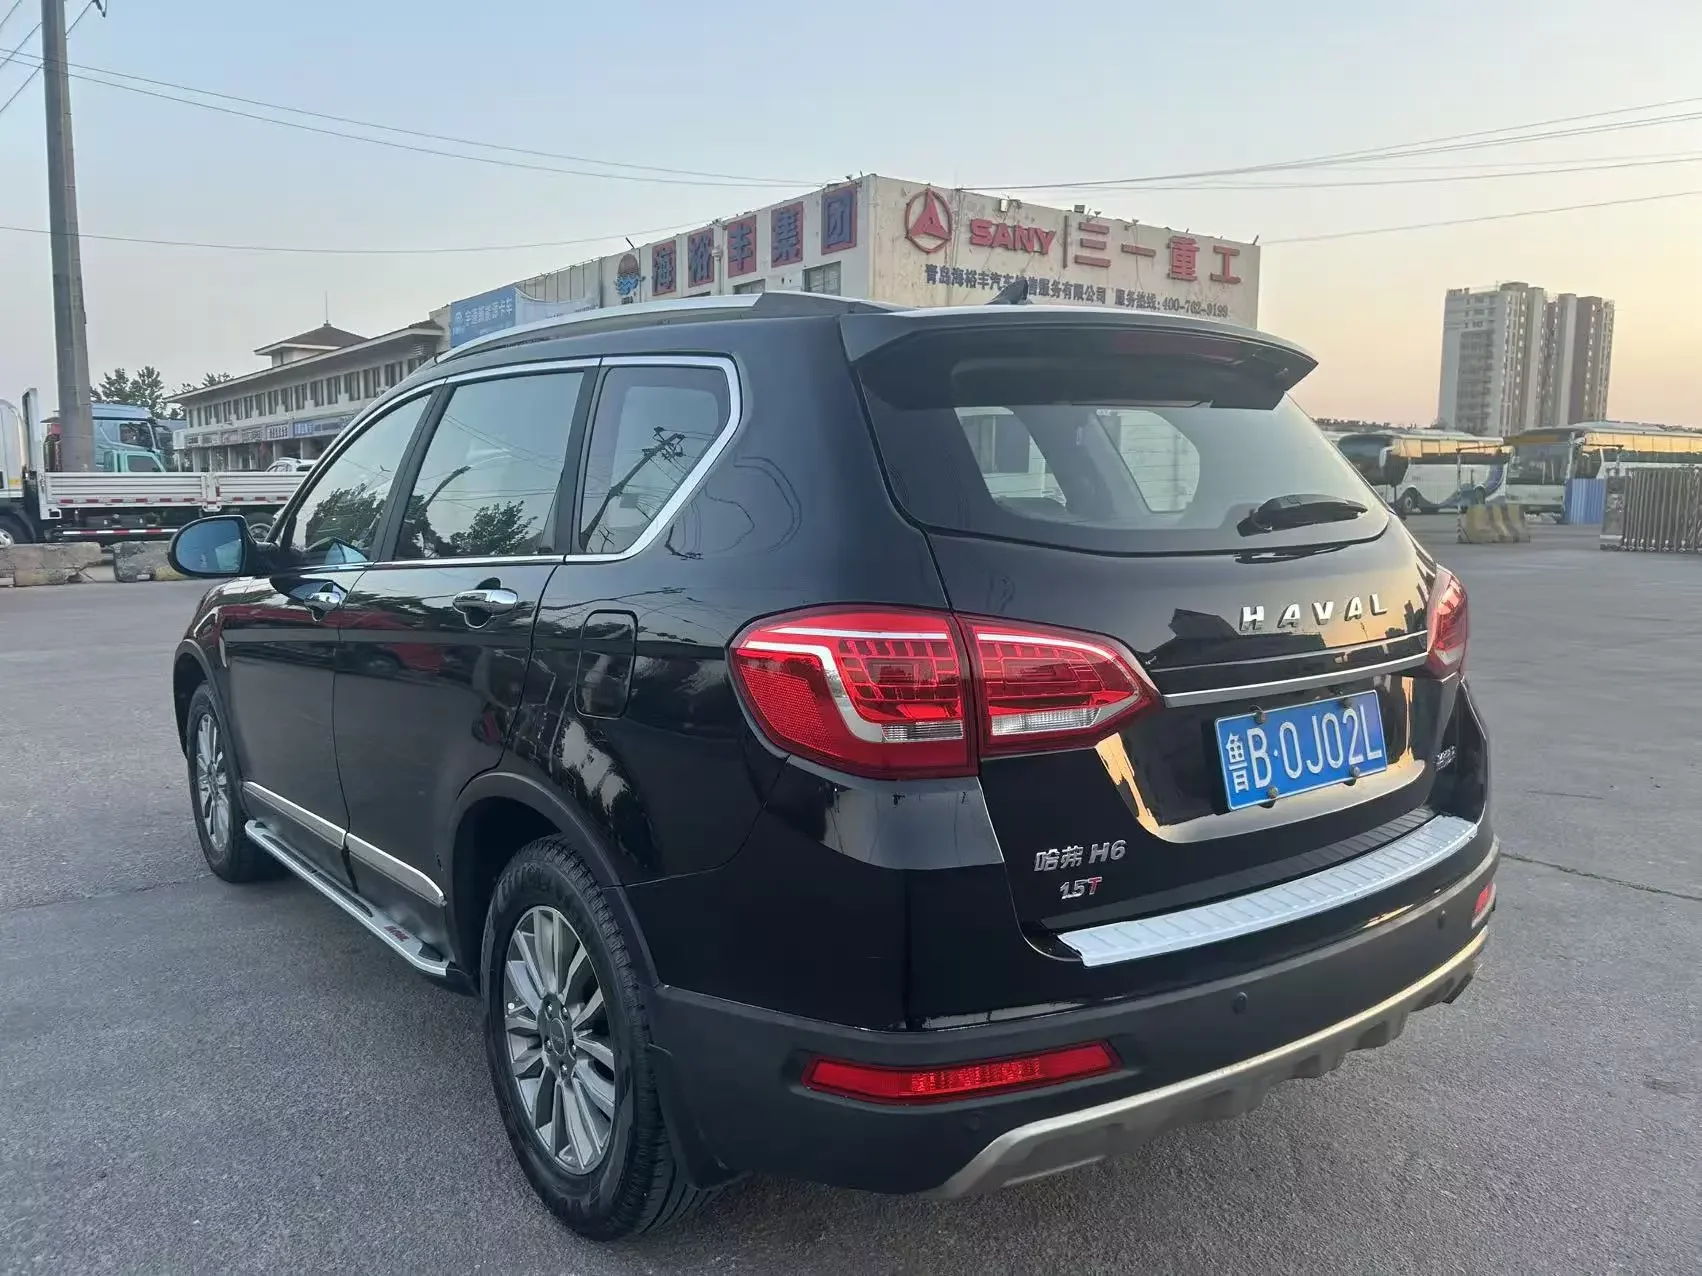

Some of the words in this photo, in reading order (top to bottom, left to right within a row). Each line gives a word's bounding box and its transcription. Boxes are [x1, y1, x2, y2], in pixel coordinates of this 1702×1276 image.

[969, 218, 1056, 255] SANY
[1074, 221, 1241, 284] 三一重工
[1239, 593, 1388, 631] HAVAL
[1033, 844, 1084, 872] 哈弗
[1088, 839, 1127, 864] H6
